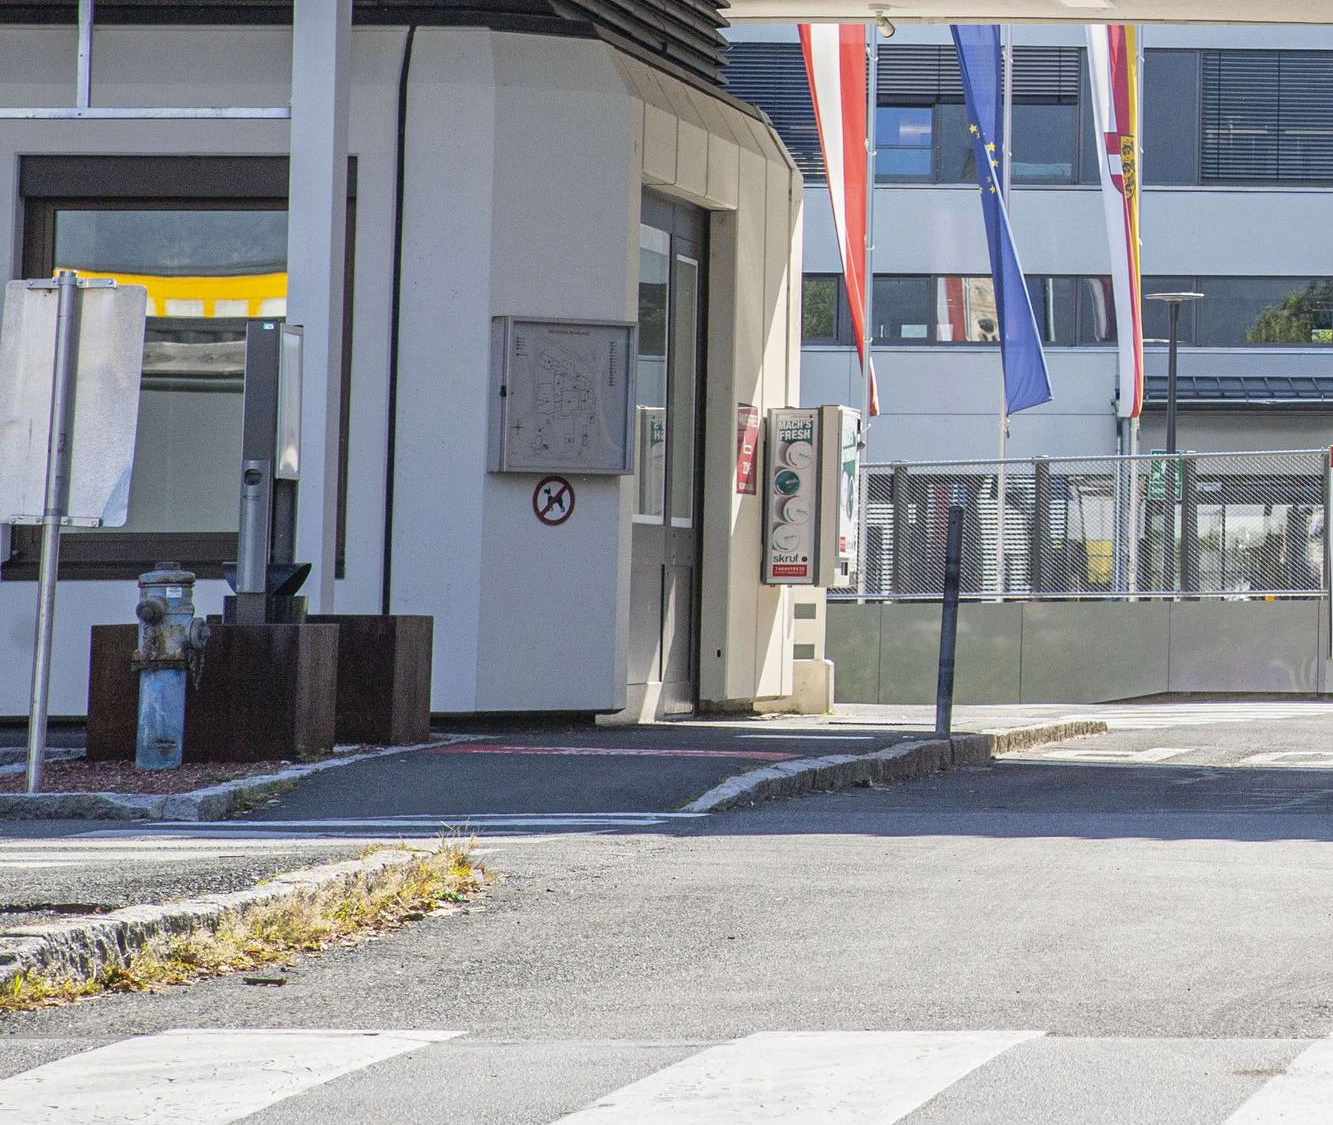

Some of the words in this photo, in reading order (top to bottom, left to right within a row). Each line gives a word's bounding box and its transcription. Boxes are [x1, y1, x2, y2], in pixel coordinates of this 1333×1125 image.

[778, 420, 812, 431] MACH'S
[778, 429, 811, 441] FRESH
[773, 553, 799, 563] skruf
